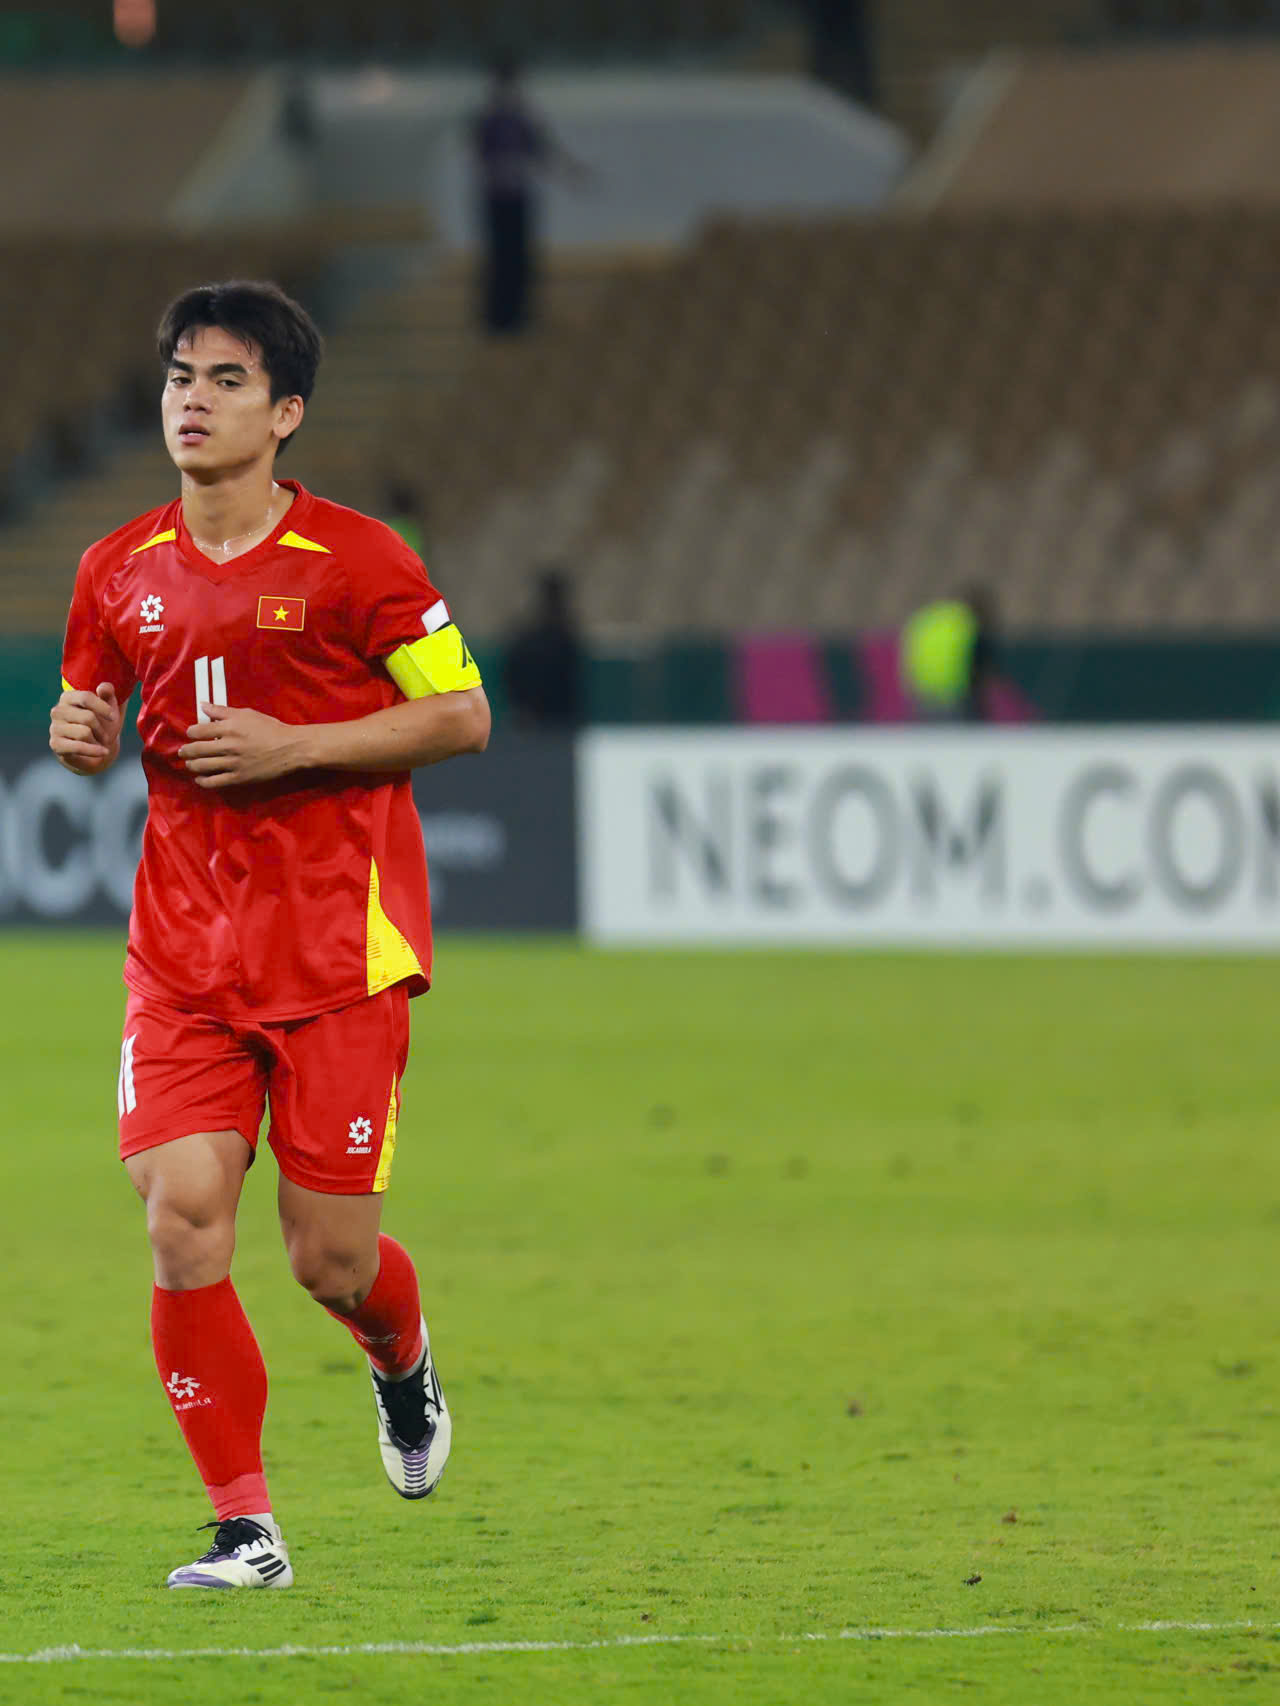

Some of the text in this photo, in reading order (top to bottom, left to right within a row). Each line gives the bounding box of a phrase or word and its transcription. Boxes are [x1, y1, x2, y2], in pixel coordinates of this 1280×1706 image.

[195, 655, 228, 724] 11
[647, 762, 1280, 914] NEOM.CO
[117, 1032, 138, 1121] 11
